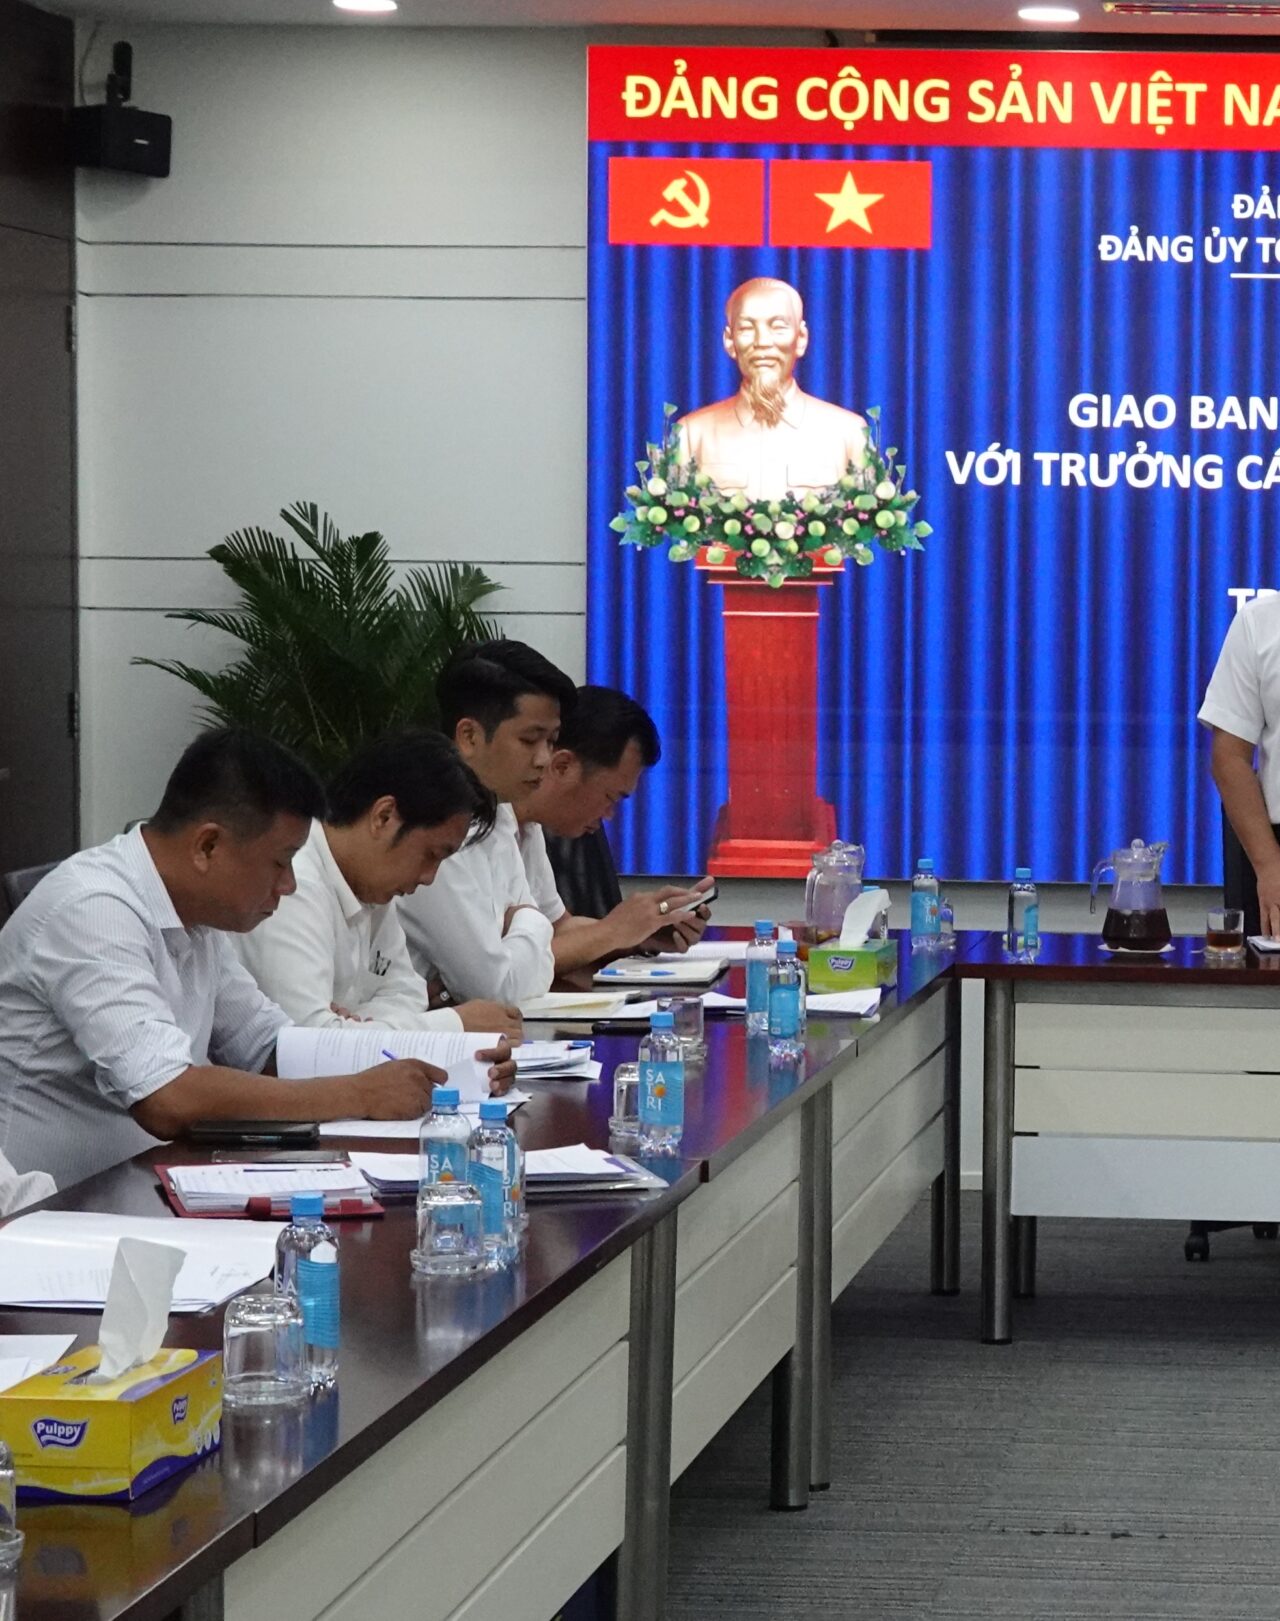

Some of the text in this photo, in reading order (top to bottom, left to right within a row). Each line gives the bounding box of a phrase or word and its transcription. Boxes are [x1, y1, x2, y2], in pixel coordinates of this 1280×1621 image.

[621, 58, 778, 121] ĐẢNG
[796, 65, 950, 131] CỘNG
[967, 63, 1073, 124] SẢN
[1089, 70, 1208, 135] VIỆT
[1097, 224, 1194, 263] ĐẢNG
[1204, 226, 1249, 264] ỦY
[1068, 392, 1177, 430] GIAO
[1190, 395, 1279, 431] BAN
[944, 442, 1021, 487] VỚI
[1033, 440, 1224, 490] TRƯỞNG
[36, 1421, 82, 1440] Pulppy
